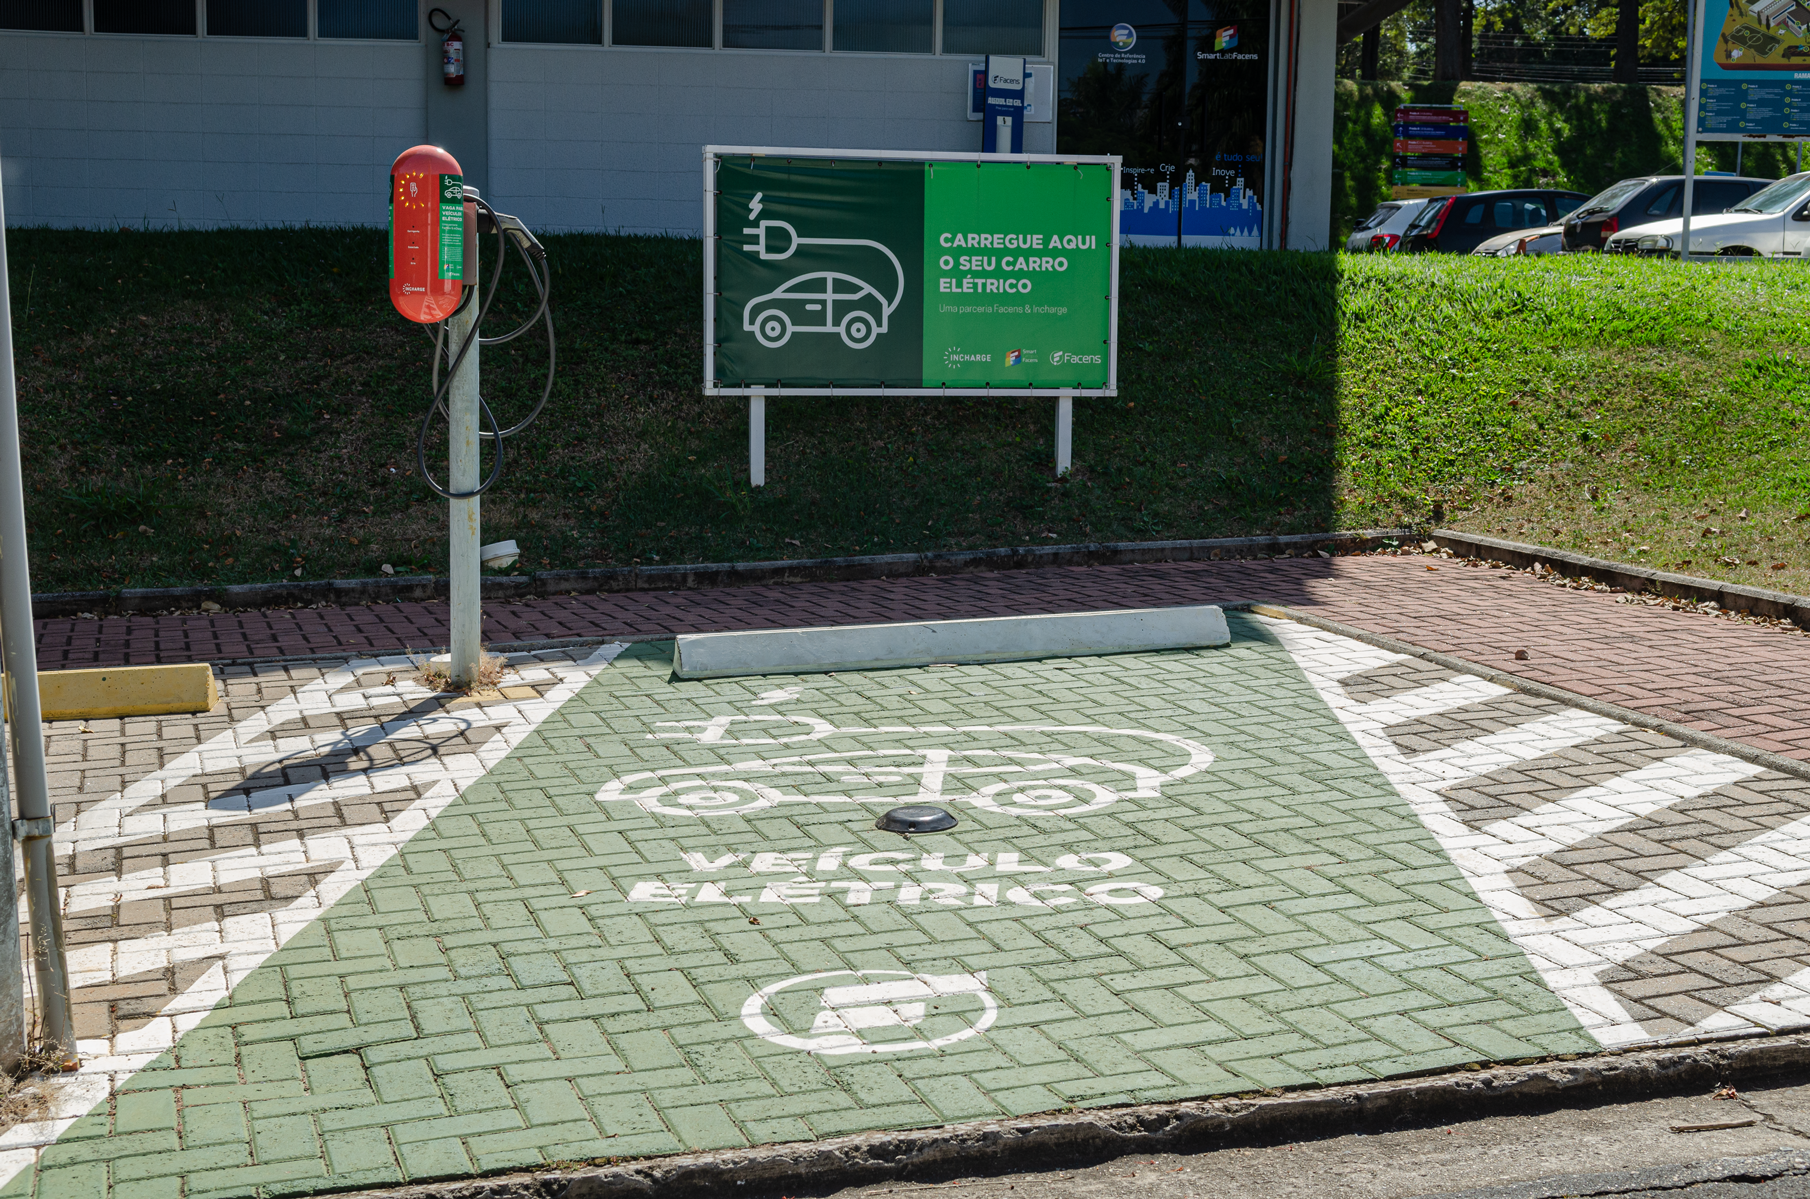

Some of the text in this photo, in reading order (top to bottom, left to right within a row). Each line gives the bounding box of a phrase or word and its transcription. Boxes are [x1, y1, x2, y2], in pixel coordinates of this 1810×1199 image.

[1196, 52, 1258, 60] SmartLabFacens
[1216, 152, 1263, 162] é tudo seu!
[1160, 164, 1175, 172] Crie
[1212, 167, 1235, 176] Inove
[940, 233, 1096, 250] CARREGUE AQUI
[940, 256, 1068, 271] O SEU CARRO
[940, 274, 1032, 293] ELÉTRICO
[939, 304, 1068, 315] Uma parceria Facens & Incharge
[1064, 353, 1101, 364] Facens
[680, 847, 1134, 872] VEÍCULO
[628, 876, 1164, 906] ELÉTRICO
